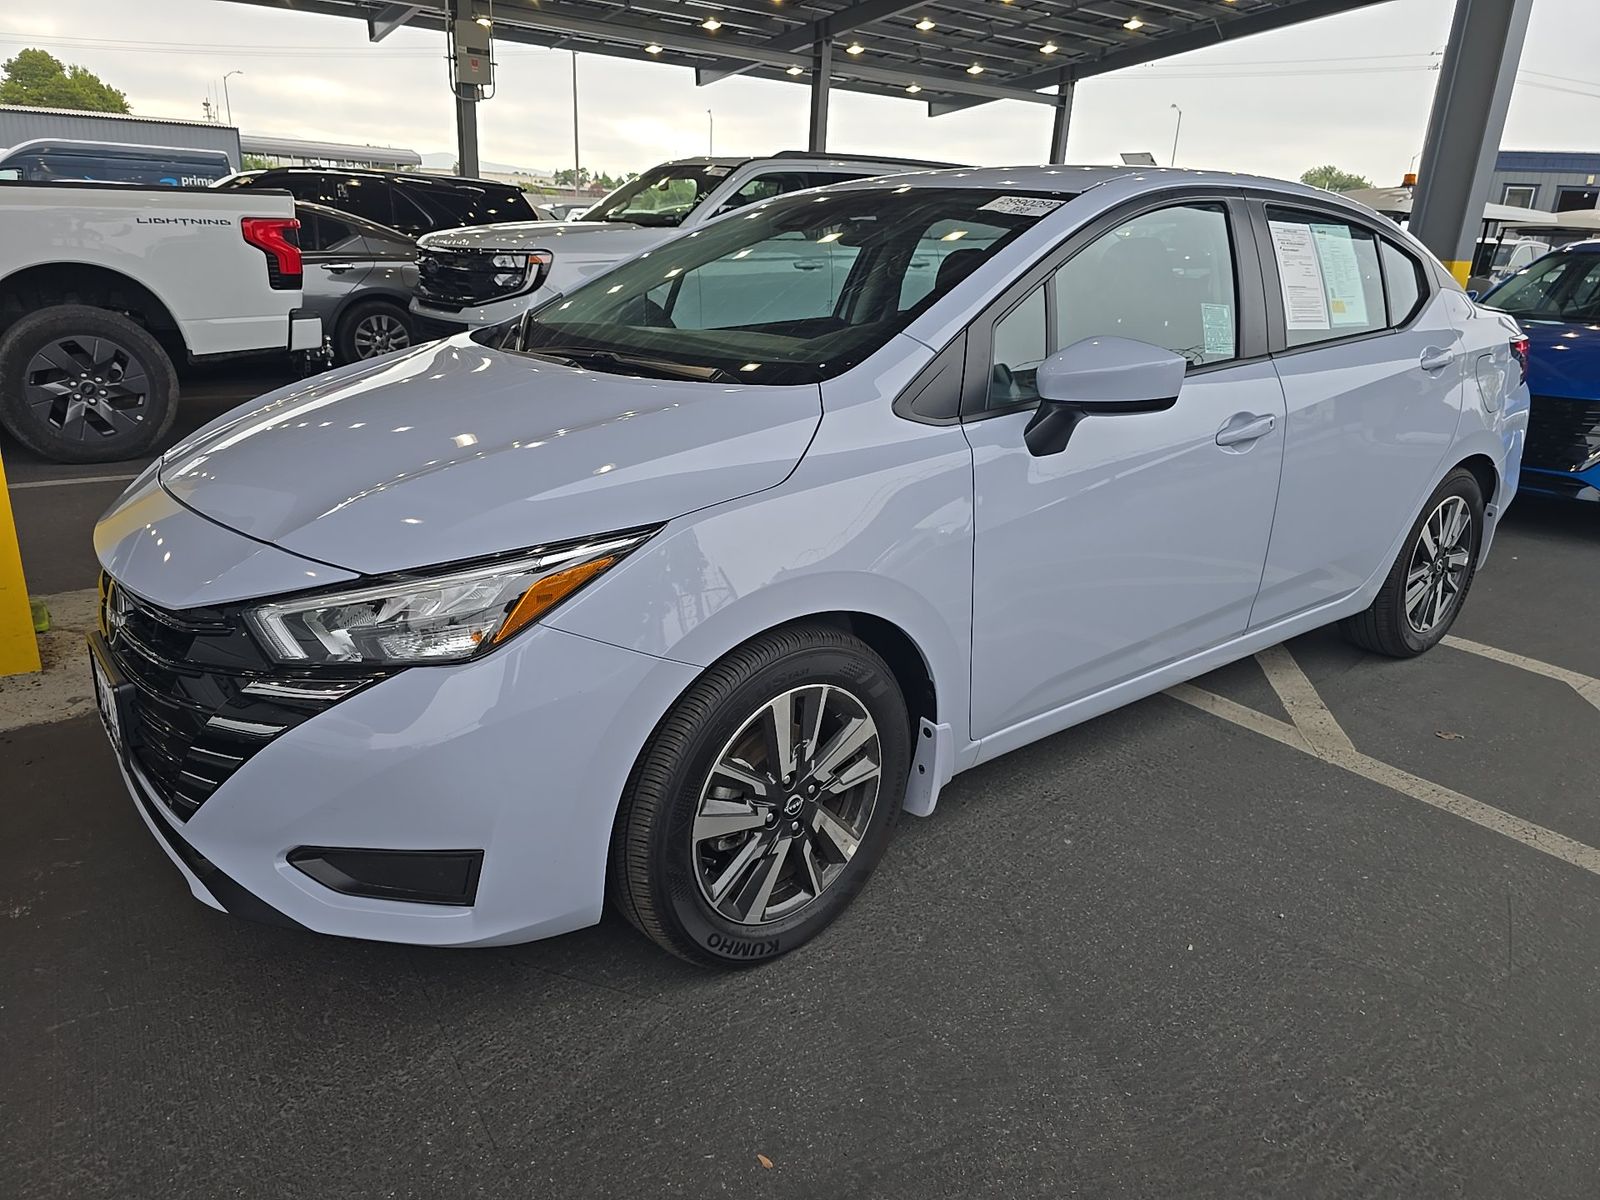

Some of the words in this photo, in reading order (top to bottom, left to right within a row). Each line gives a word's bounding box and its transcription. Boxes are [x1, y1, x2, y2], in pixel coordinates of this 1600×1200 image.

[181, 174, 214, 187] prime
[136, 217, 231, 226] LIGHTNING
[707, 933, 780, 956] KUMHO
